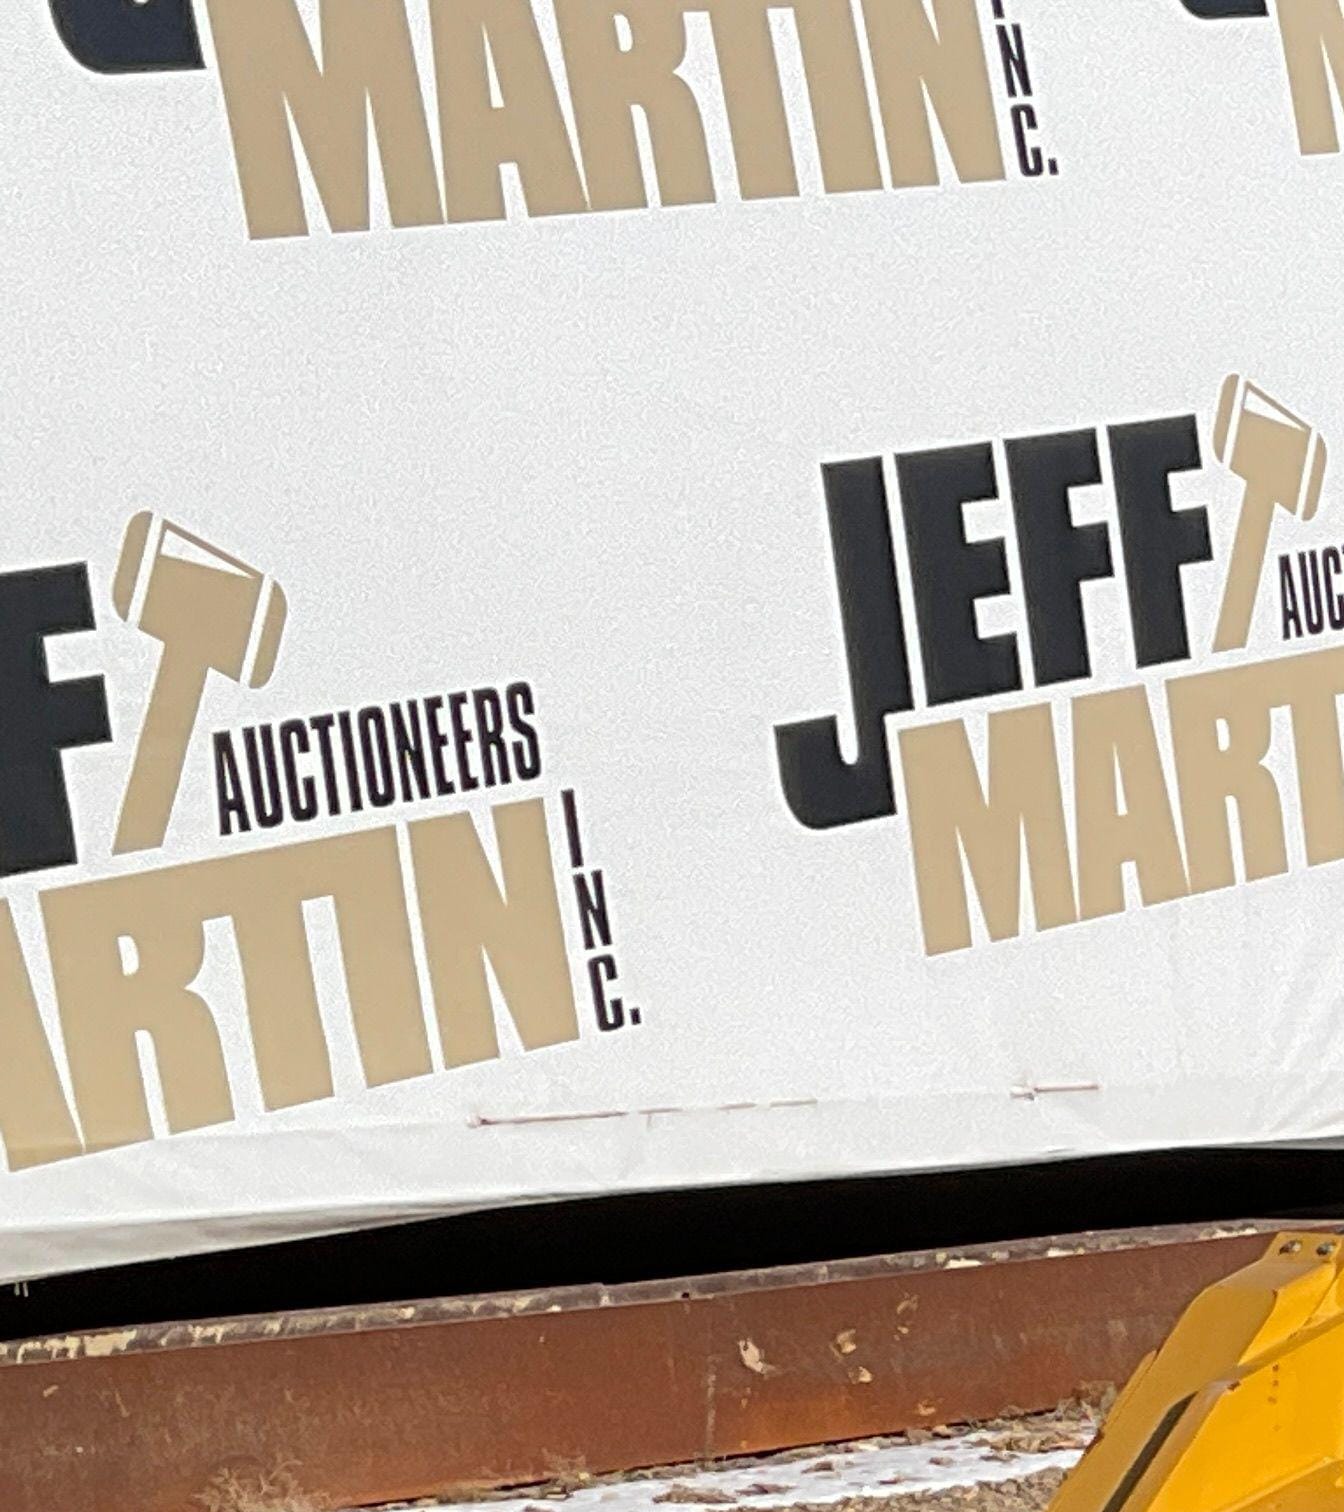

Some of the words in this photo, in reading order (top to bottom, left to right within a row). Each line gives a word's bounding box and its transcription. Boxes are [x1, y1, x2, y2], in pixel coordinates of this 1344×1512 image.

[206, 0, 1006, 240] MARTIN
[992, 0, 1059, 177] NC.
[773, 414, 1214, 830] JEFF
[212, 681, 543, 836] AUCTIONEERS
[0, 796, 581, 1172] RTIN
